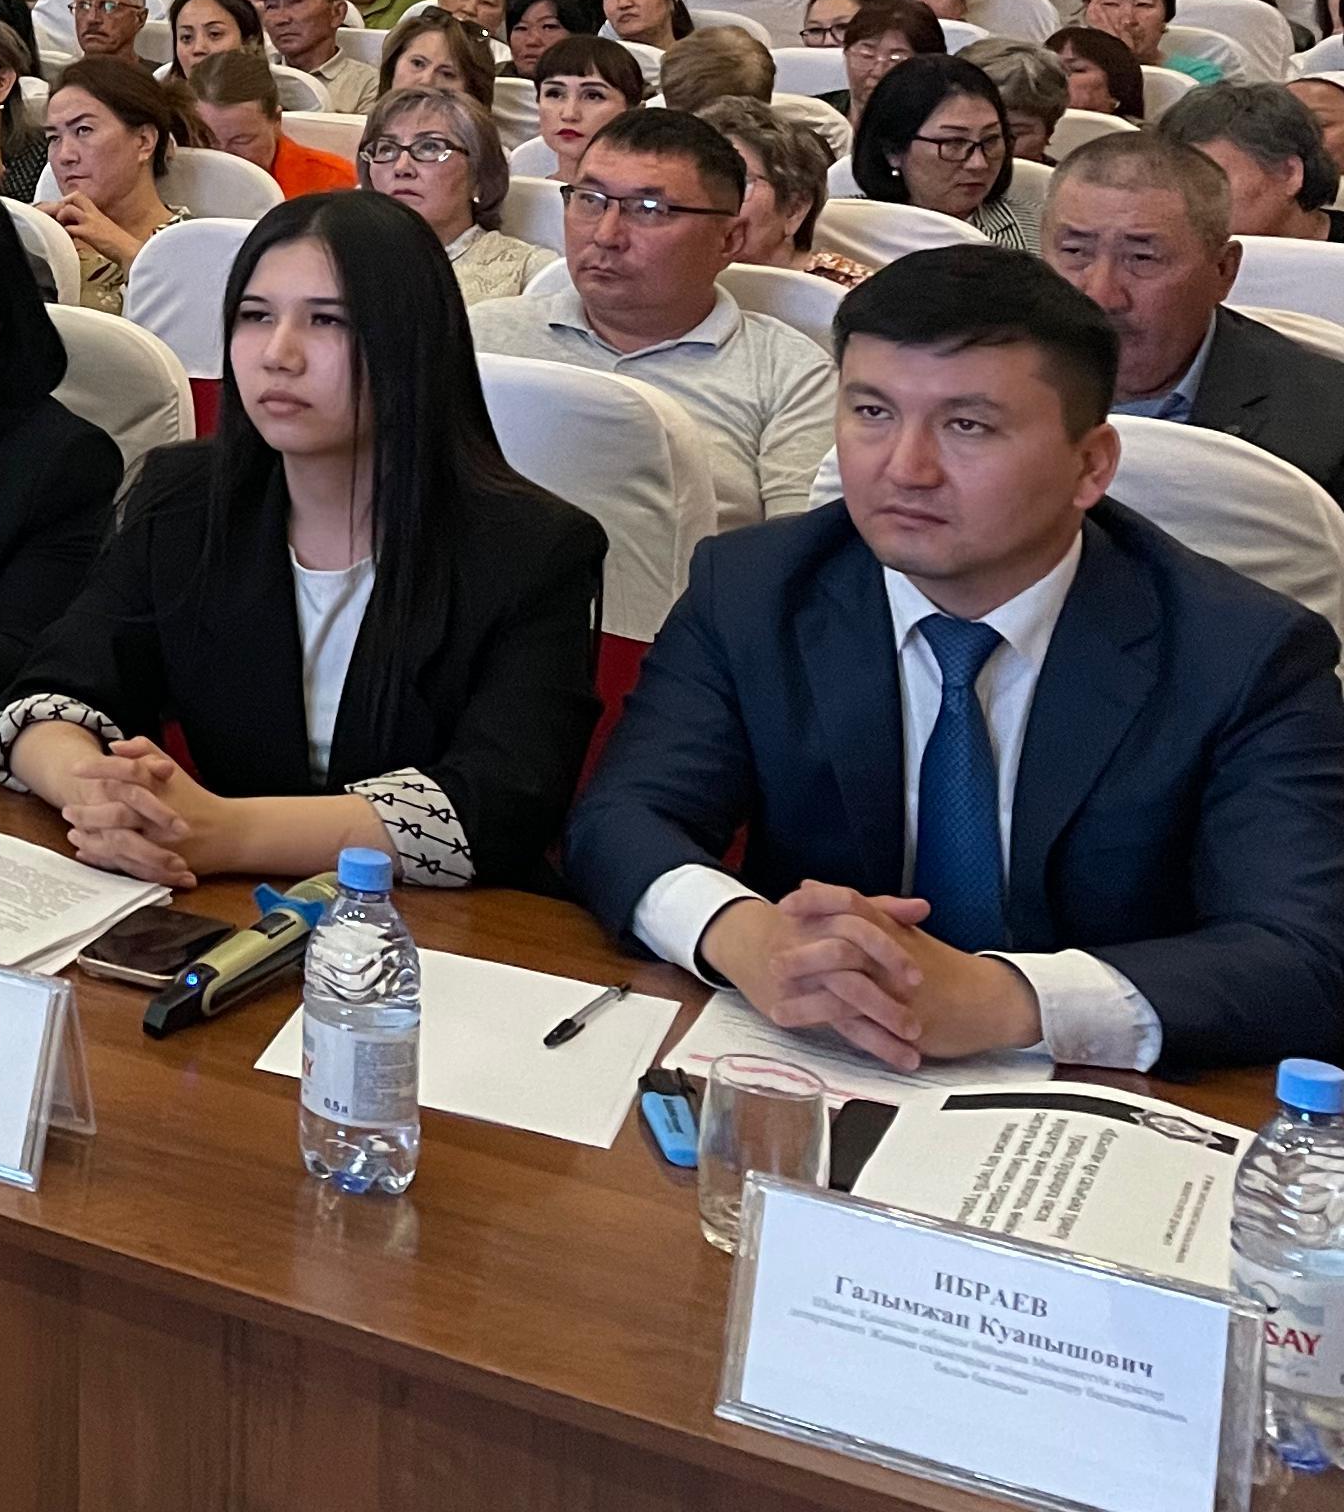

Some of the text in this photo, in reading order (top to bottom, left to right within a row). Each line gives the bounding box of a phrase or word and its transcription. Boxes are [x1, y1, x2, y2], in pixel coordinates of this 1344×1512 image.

[834, 1275, 971, 1331] Галымжан
[979, 1317, 1154, 1379] Куанышович
[934, 1271, 1049, 1319] ИБРАЕВ
